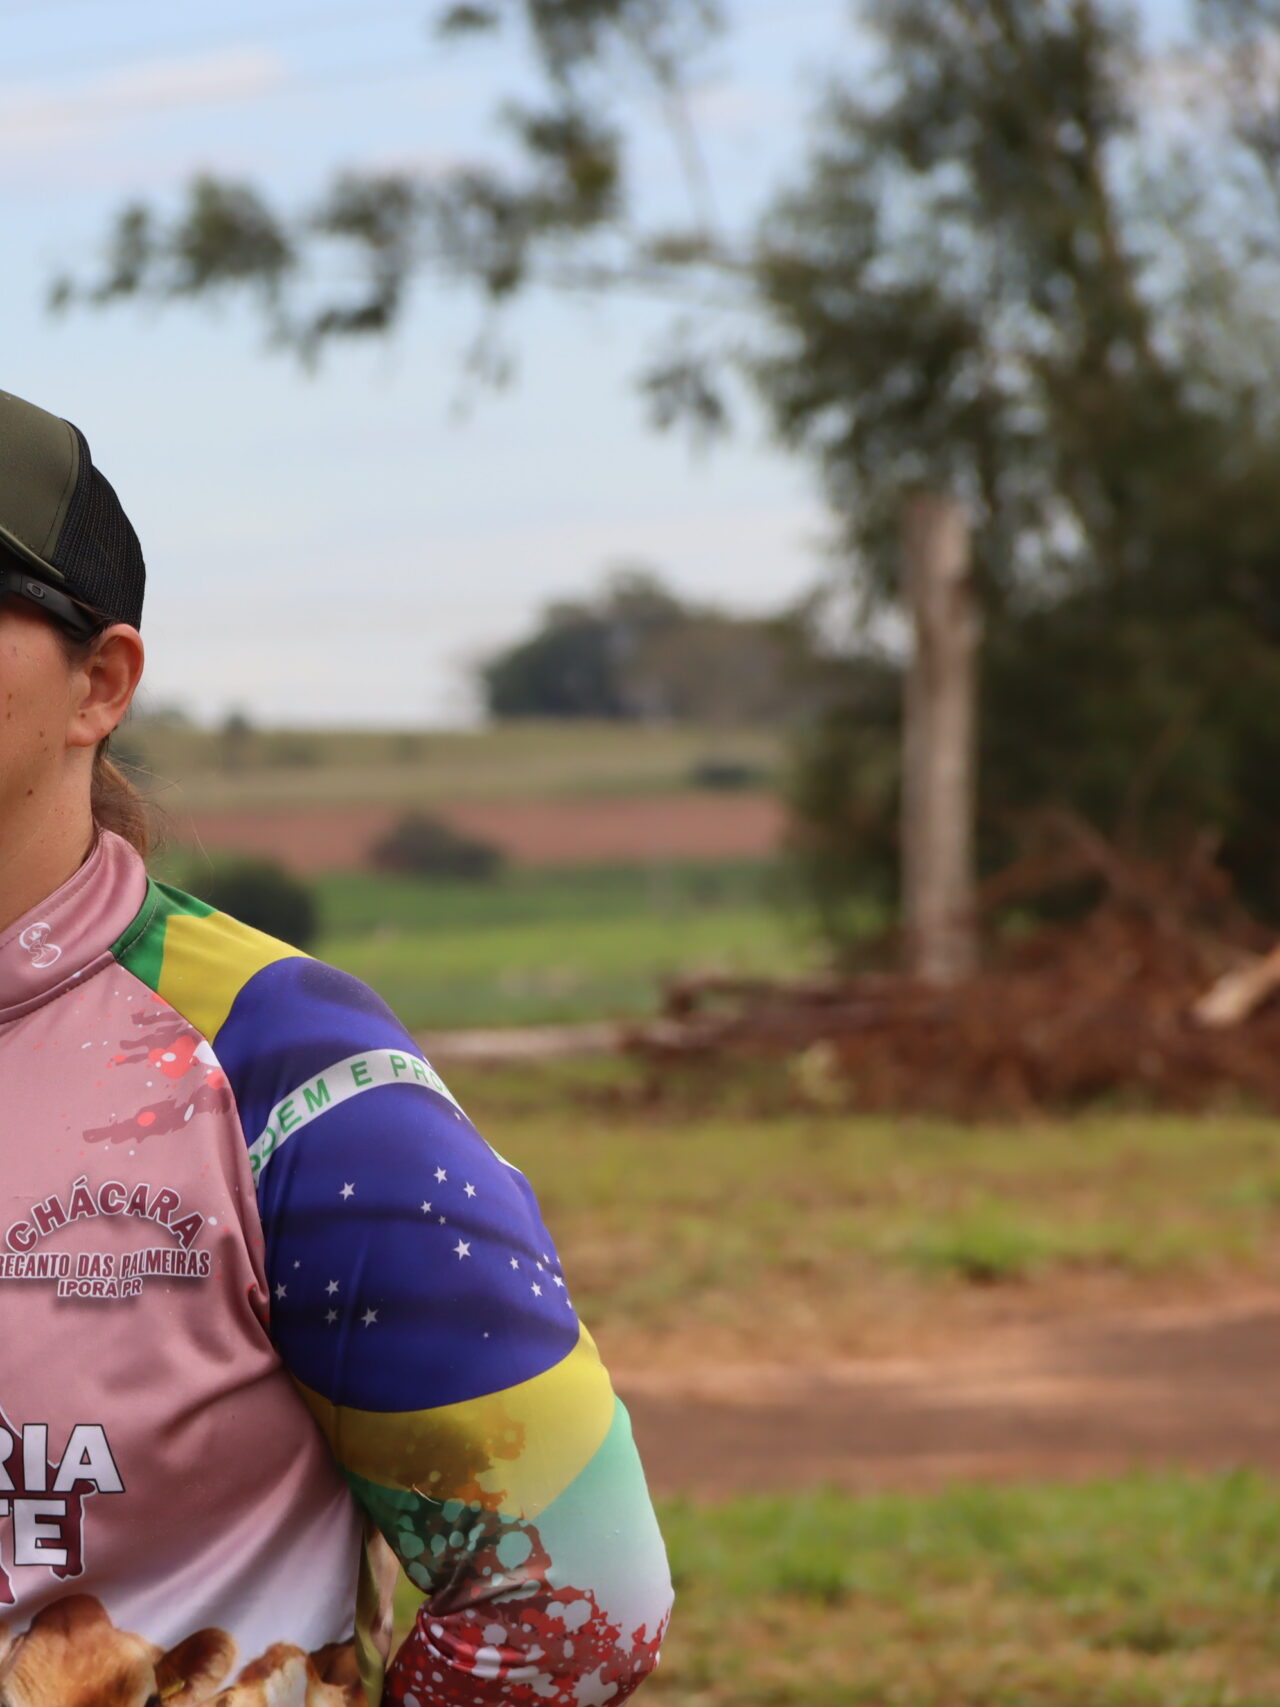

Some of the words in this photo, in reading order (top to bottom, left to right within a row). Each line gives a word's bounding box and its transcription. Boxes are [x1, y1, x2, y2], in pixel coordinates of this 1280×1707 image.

[350, 1060, 372, 1087] E
[6, 1175, 204, 1253] CHÁCARA
[77, 1253, 116, 1279] DAS
[120, 1248, 211, 1279] PALMEIRAS
[121, 1277, 143, 1298] PR
